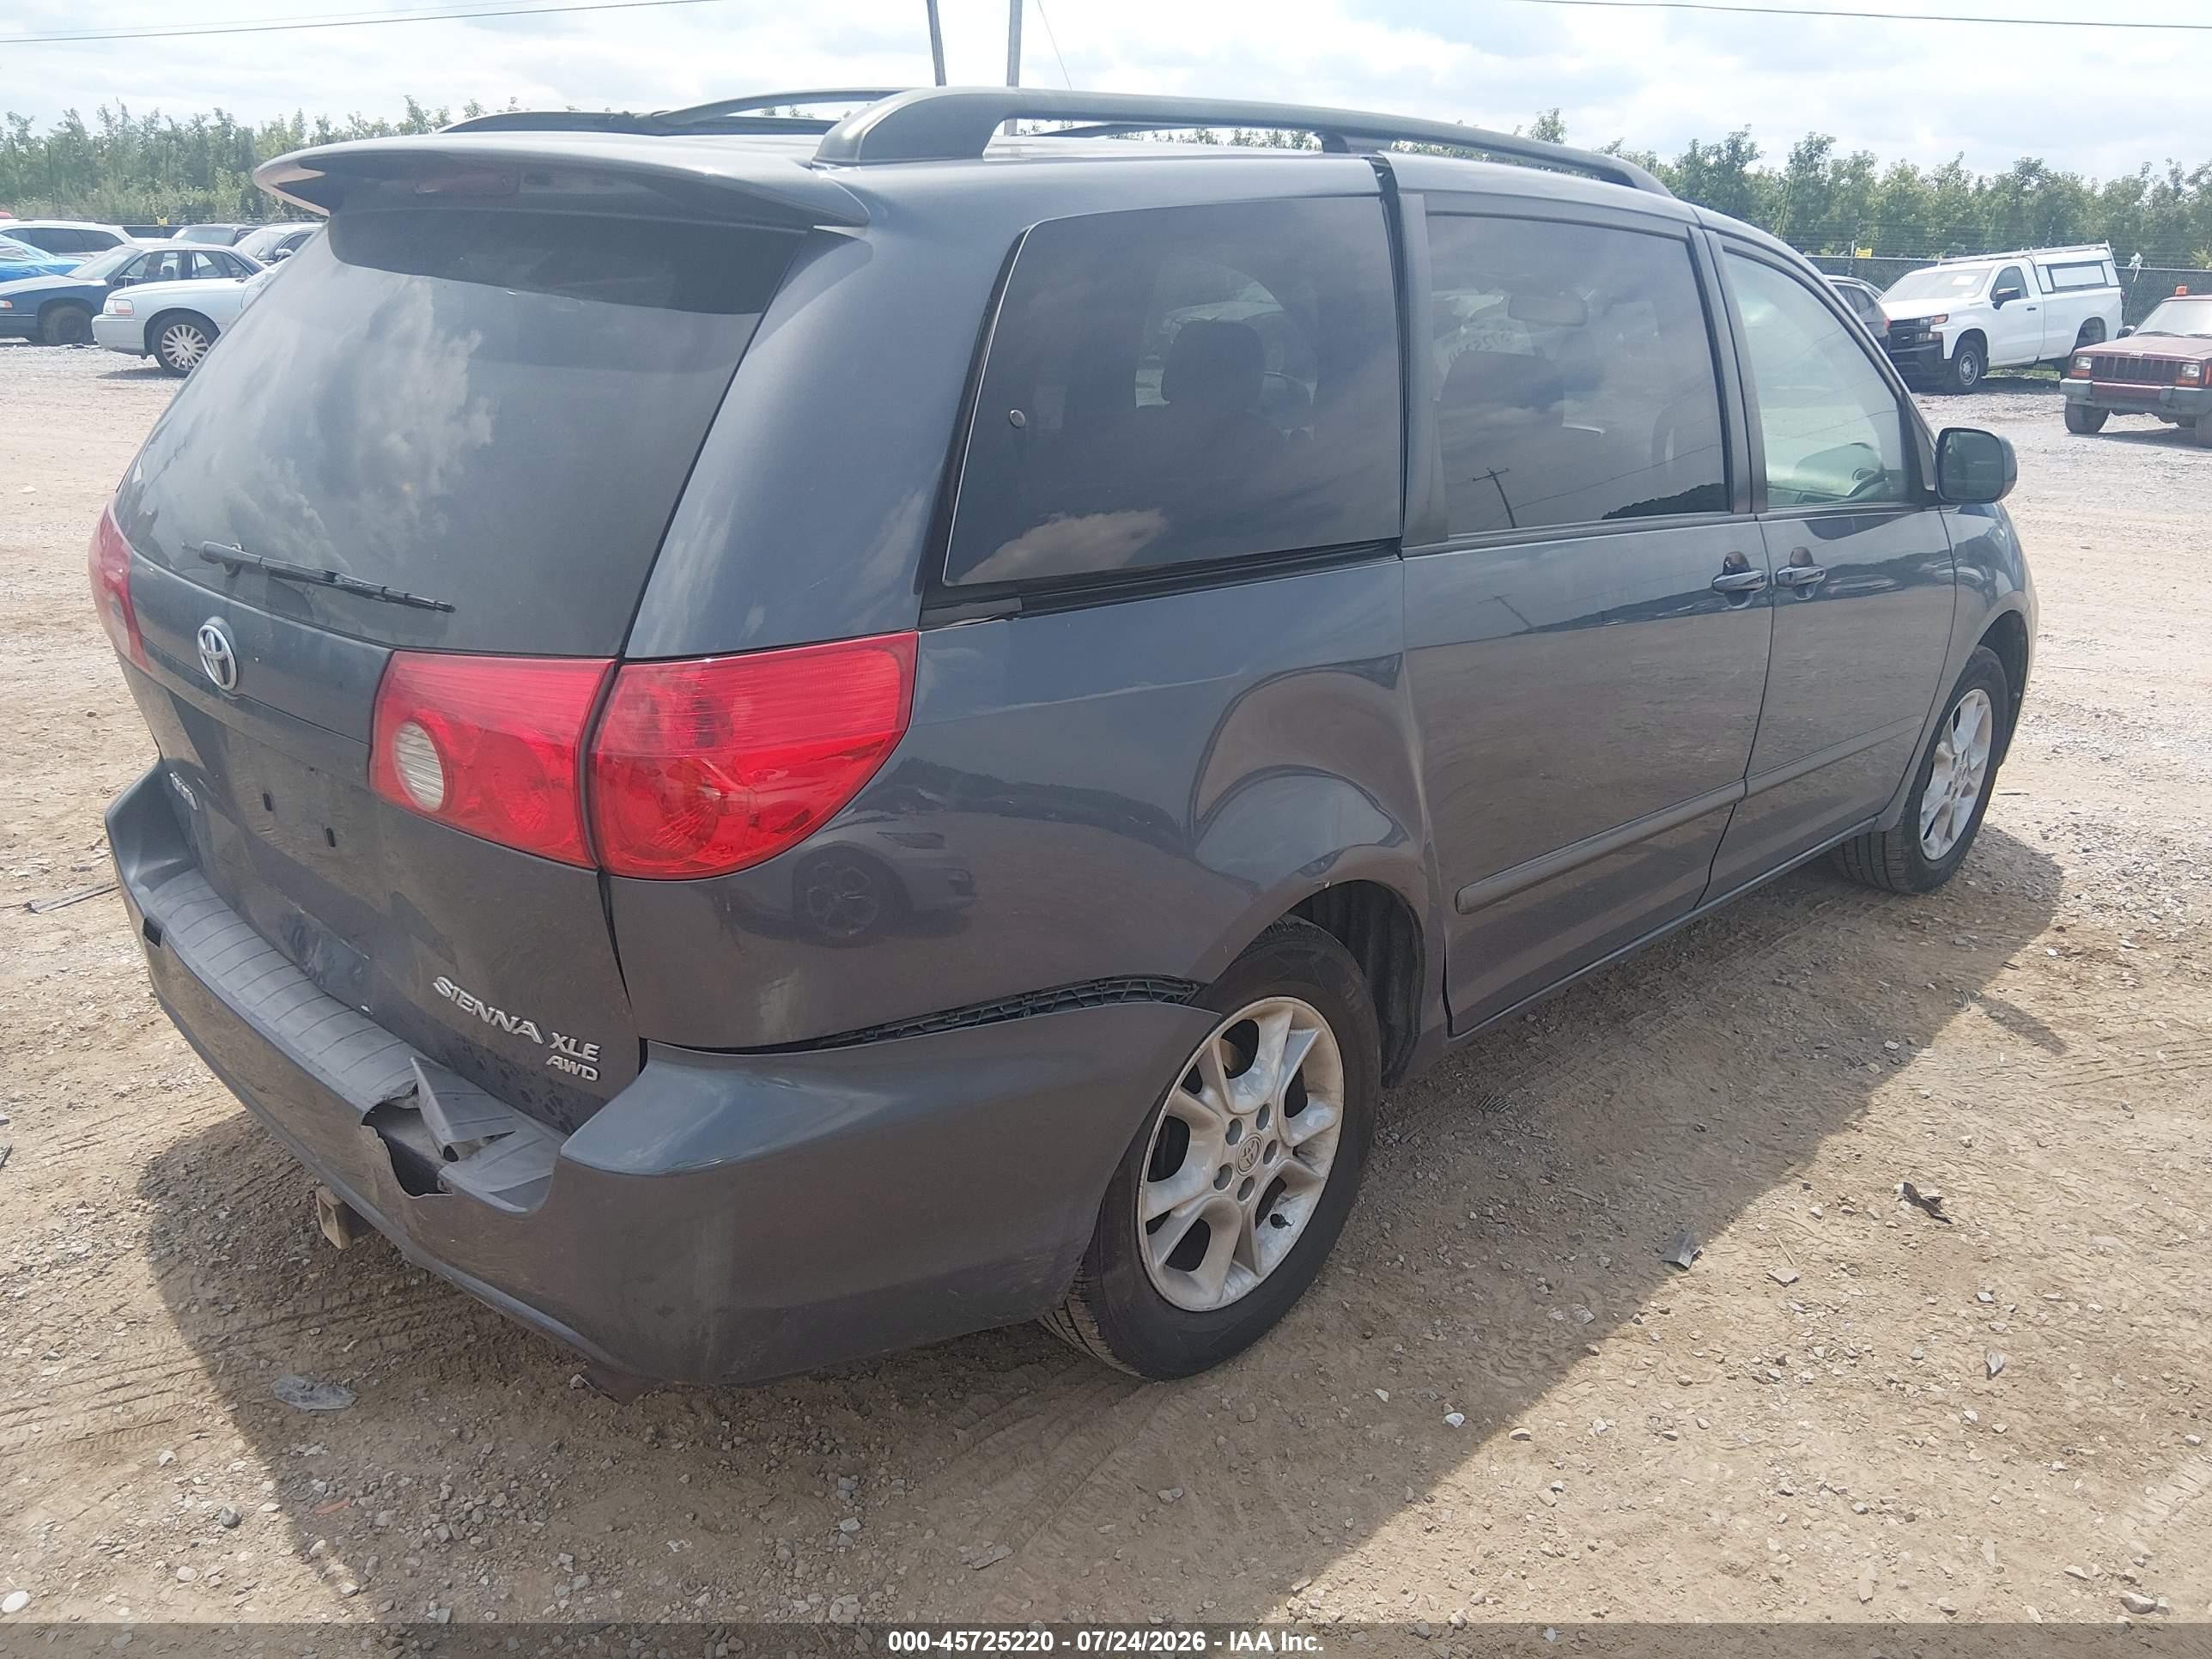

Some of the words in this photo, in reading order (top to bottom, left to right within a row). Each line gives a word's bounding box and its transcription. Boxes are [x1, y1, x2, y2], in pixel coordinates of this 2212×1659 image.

[433, 976, 544, 1044] SIENNA
[550, 1031, 600, 1062] XLE
[545, 1054, 599, 1081] AWD
